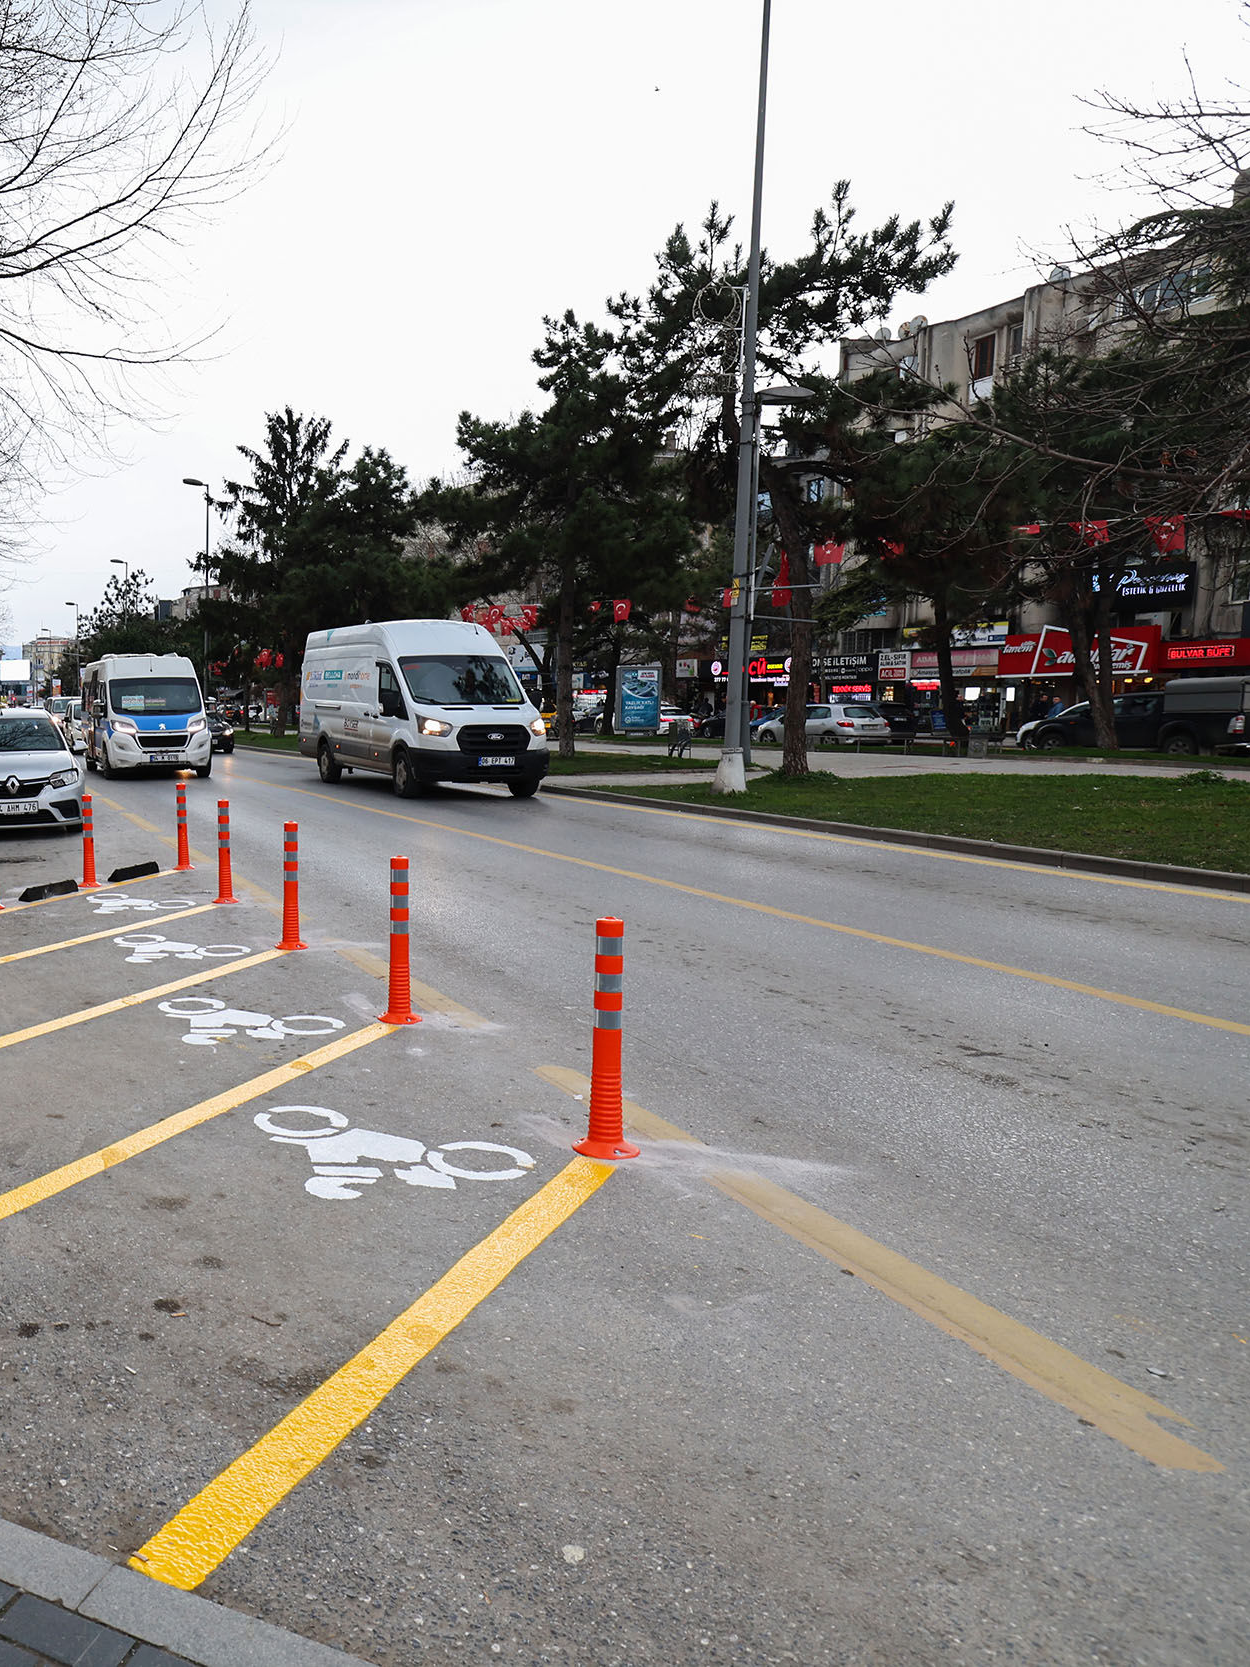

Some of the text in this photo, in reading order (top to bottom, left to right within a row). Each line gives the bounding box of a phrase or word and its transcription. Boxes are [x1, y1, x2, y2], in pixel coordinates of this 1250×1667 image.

[1170, 647, 1231, 660] BULVAR BÜFE
[833, 656, 867, 668] İLETİŞİM
[7, 804, 20, 812] AHM
[24, 803, 37, 812] 476
